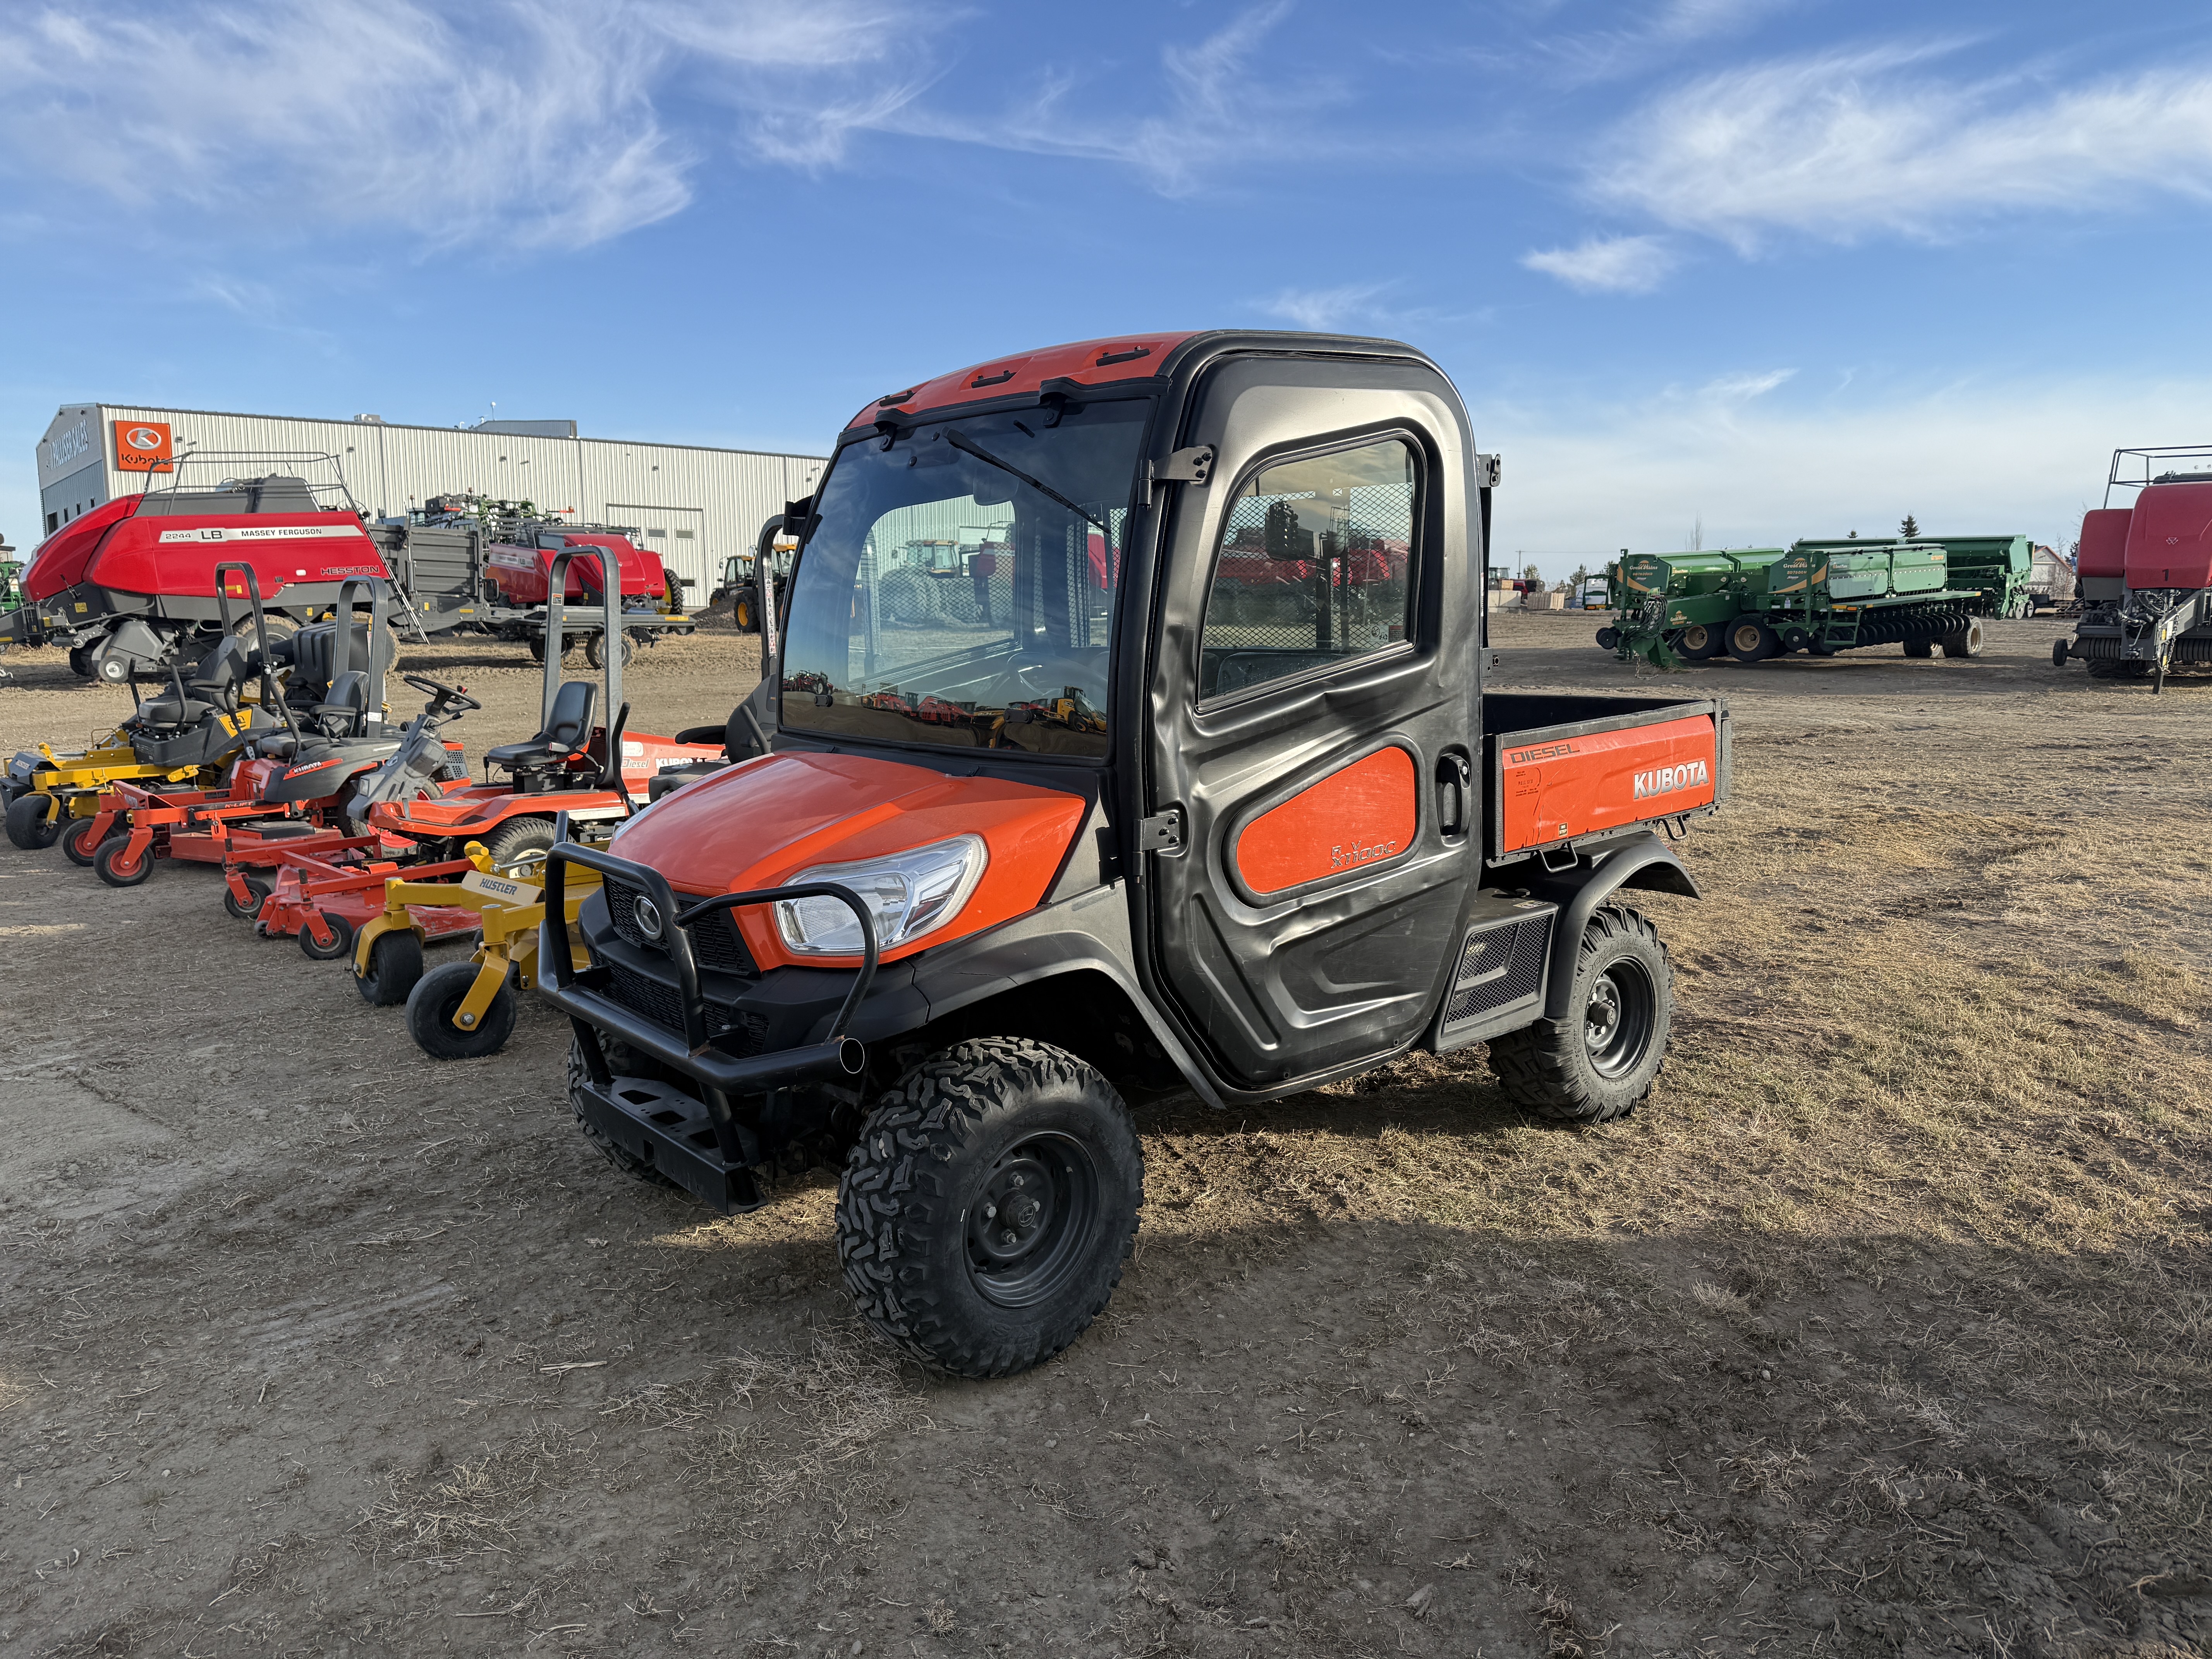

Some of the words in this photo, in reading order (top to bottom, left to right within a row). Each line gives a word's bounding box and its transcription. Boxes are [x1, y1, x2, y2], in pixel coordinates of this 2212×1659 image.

[52, 430, 74, 468] PALLISER
[72, 419, 89, 457] SALES
[201, 531, 223, 539] LB
[321, 565, 380, 575] HESSTON
[2162, 568, 2169, 581] 1
[1510, 744, 1580, 764] DIESEL
[622, 757, 650, 769] Diesel
[1633, 760, 1709, 799] KUBOTA
[479, 878, 518, 895] HUSTLER
